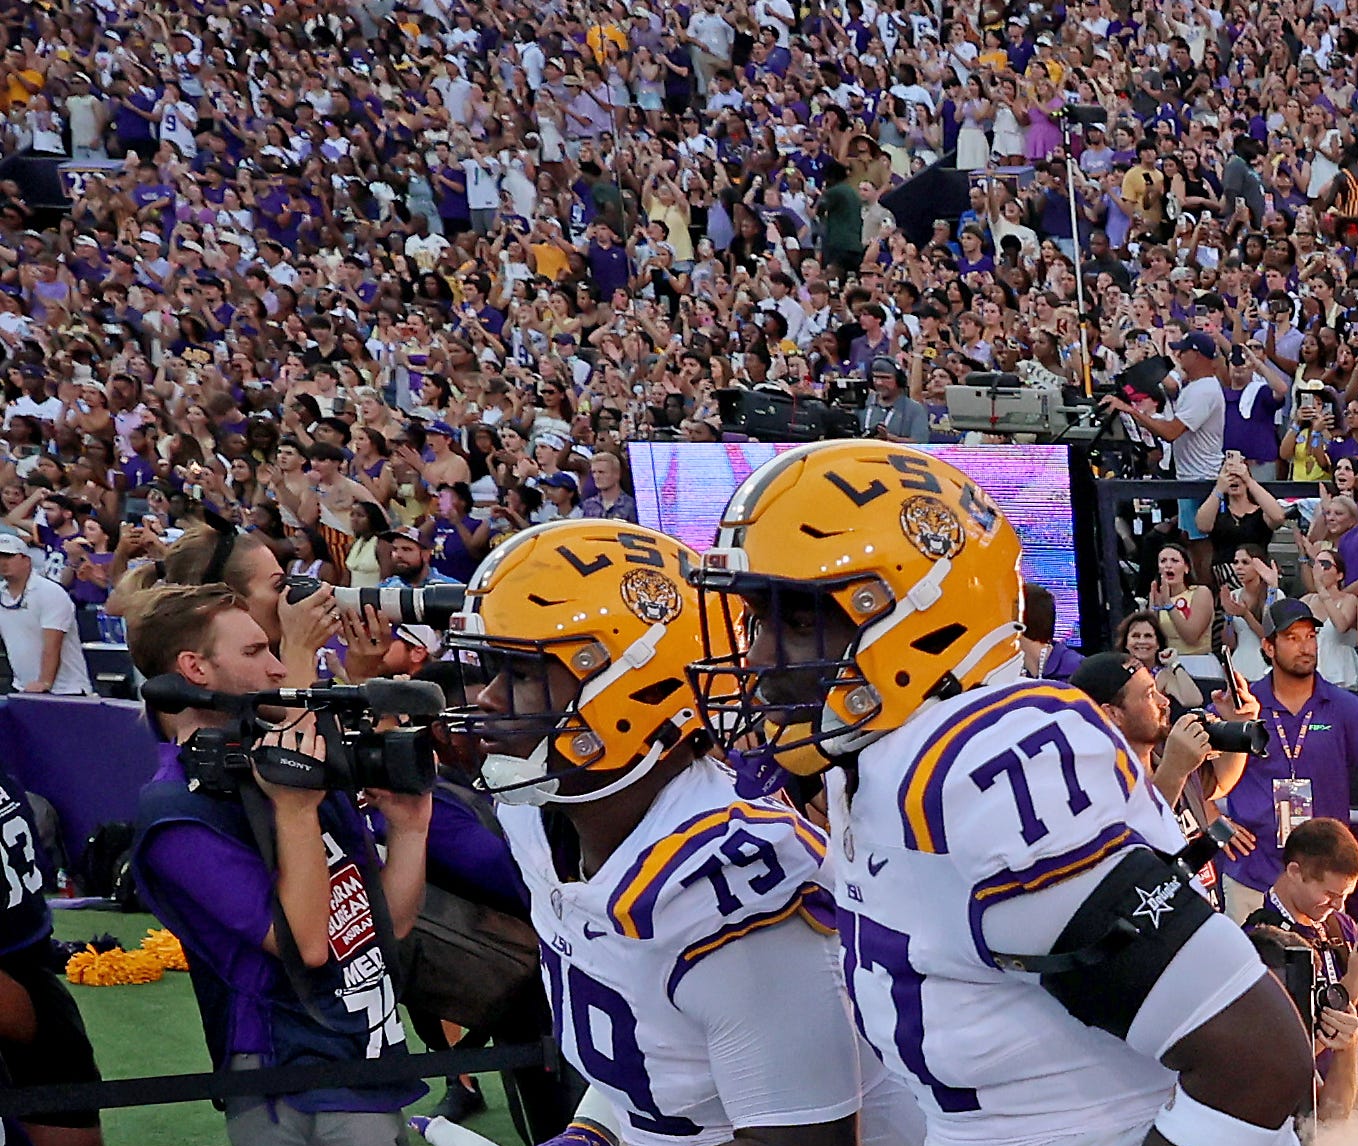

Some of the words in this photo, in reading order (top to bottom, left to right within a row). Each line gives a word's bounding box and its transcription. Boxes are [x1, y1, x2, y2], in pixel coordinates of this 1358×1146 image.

[279, 758, 313, 772] SONY
[968, 722, 1093, 847] 77
[680, 828, 787, 918] 79
